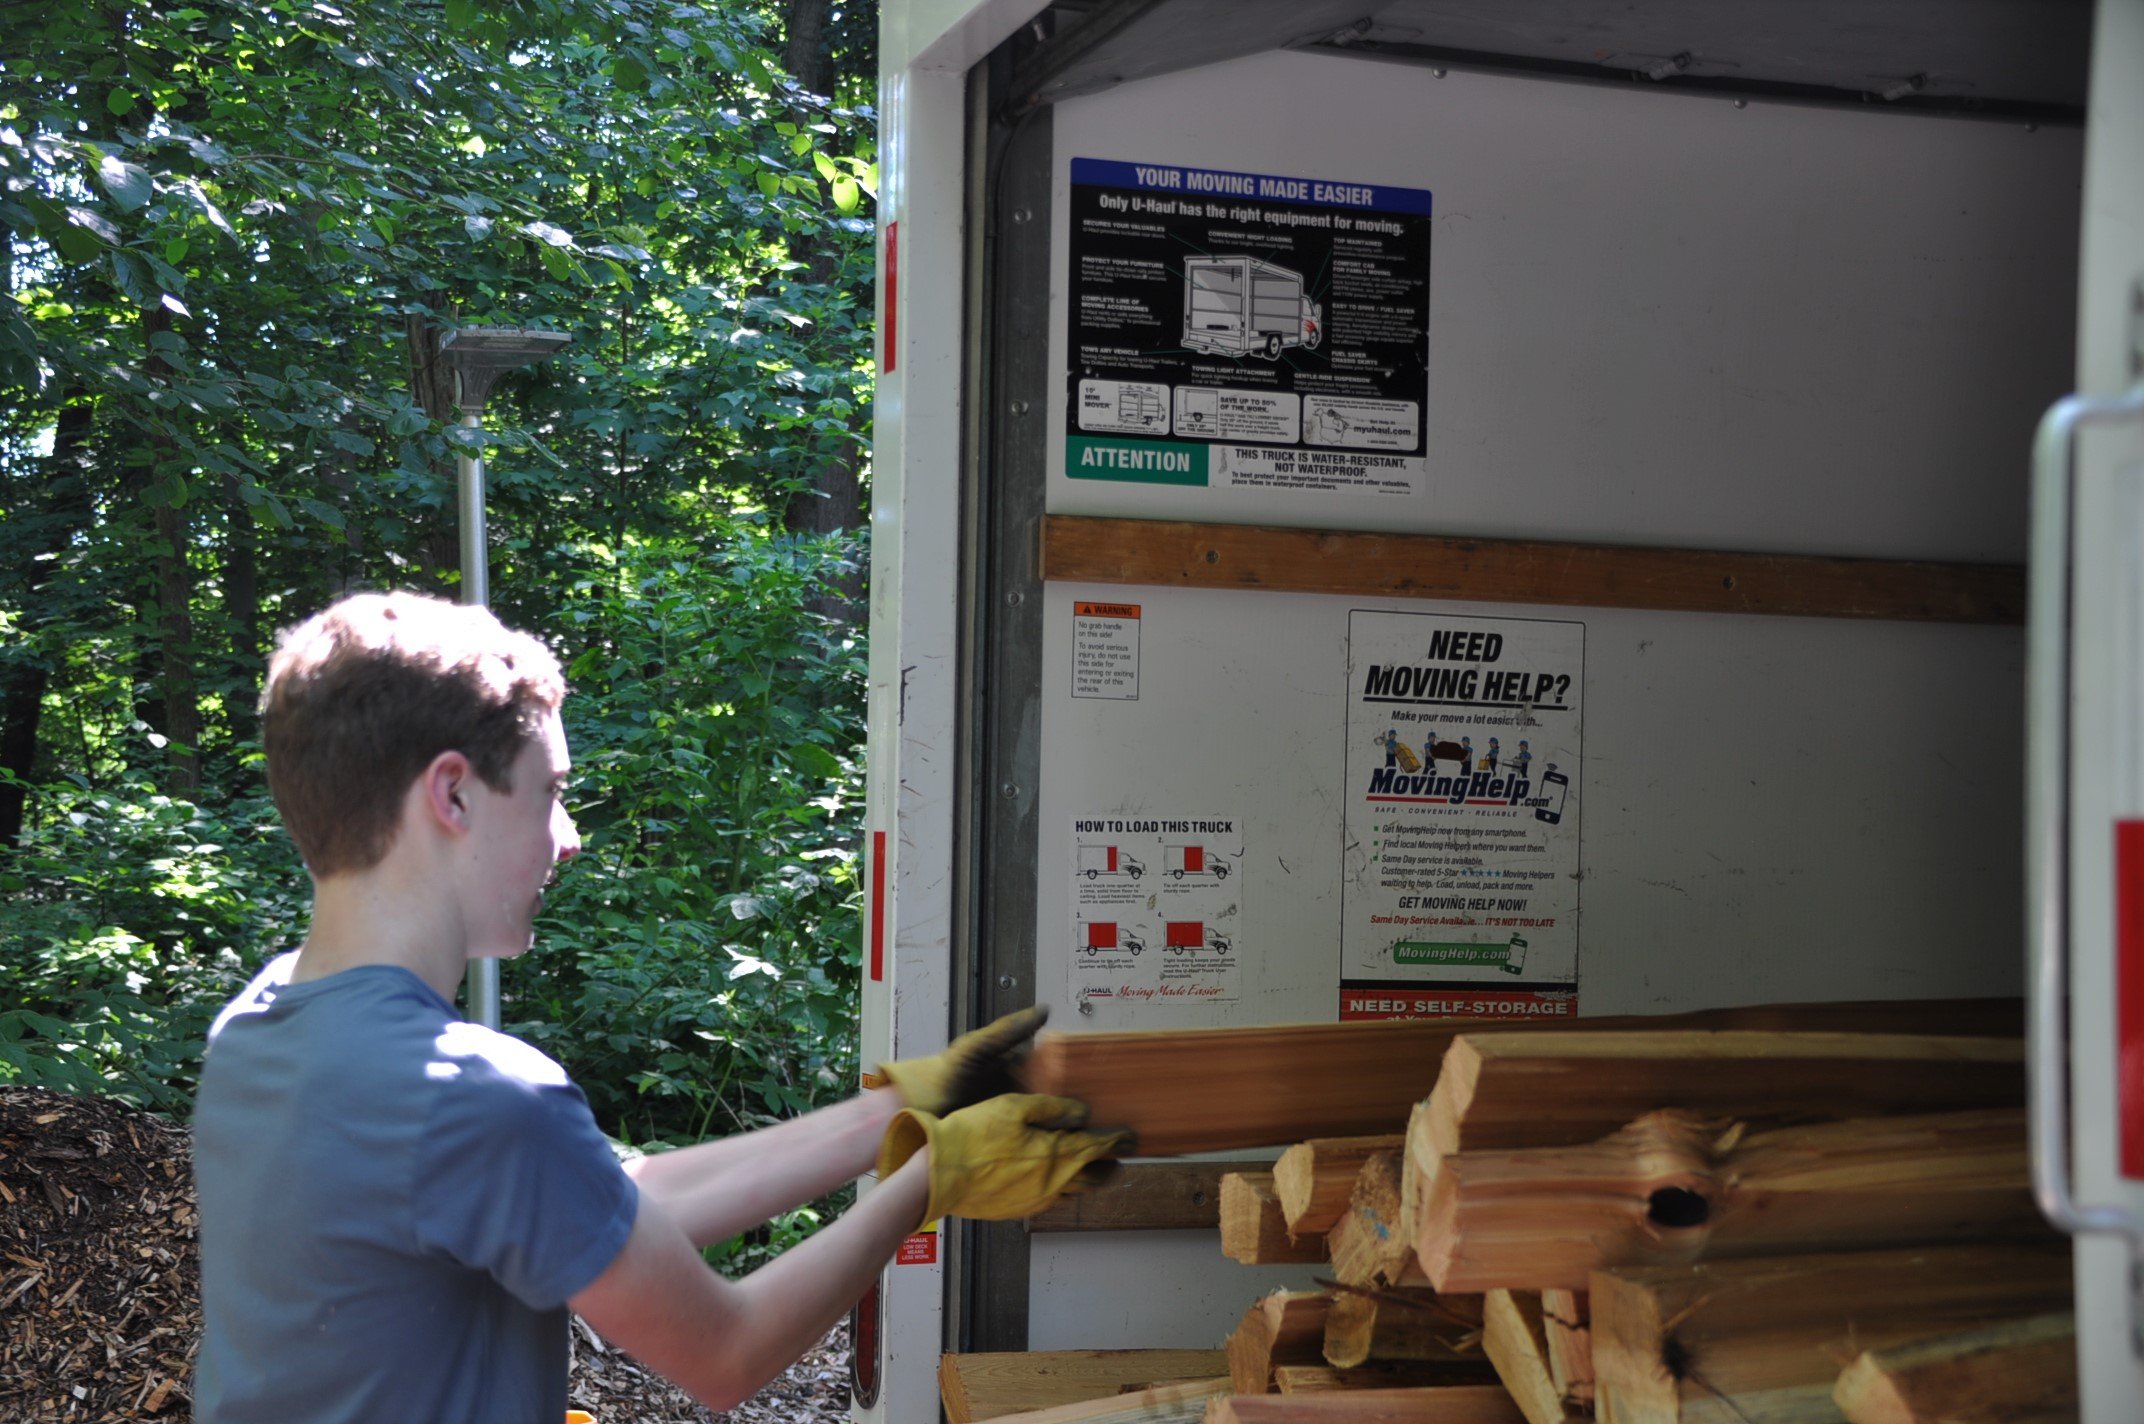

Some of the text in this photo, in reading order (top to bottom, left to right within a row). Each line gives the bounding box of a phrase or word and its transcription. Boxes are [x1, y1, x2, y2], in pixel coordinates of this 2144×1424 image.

[1135, 167, 1372, 206] YOUR MOVING MADE EASIER
[1100, 194, 1404, 236] Only U-Haul has the right equipment for moving.
[1354, 426, 1410, 436] myuhaul.com
[1081, 447, 1189, 472] ATTENTION
[1235, 449, 1406, 470] THIS TRUCK IS WATER-RESISTANT,
[1275, 463, 1367, 478] NOT WATERPROOF.
[1291, 475, 1319, 483] important
[1095, 606, 1132, 616] WARNING
[1428, 630, 1503, 662] NEED
[1114, 671, 1134, 679] exiting
[1364, 665, 1571, 703] MOVING HELP?
[1392, 710, 1416, 721] Make
[1418, 713, 1438, 723] your
[1440, 714, 1464, 723] move
[1473, 715, 1485, 724] lot
[1368, 768, 1549, 807] MovingHelp.com
[1409, 808, 1464, 816] CONVENIENT
[1076, 821, 1232, 833] HOW TO LOAD THIS TRUCK
[1383, 825, 1394, 833] Get
[1396, 826, 1436, 835] MovingHelp
[1454, 827, 1470, 835] from
[1485, 829, 1526, 838] smartphone.
[1383, 840, 1400, 848] Find
[1400, 840, 1416, 848] local
[1418, 841, 1443, 850] Moving
[1445, 842, 1471, 851] Helpers
[1382, 855, 1401, 863] Same
[1403, 855, 1416, 865] Day
[1451, 856, 1483, 866] available.
[1381, 866, 1555, 880] Customer-rated 5-Star Moving Helpers
[1381, 880, 1407, 889] waiting
[1408, 880, 1415, 888] to
[1417, 880, 1432, 889] help.
[1436, 880, 1455, 889] Load,
[1456, 880, 1481, 890] unload,
[1482, 882, 1500, 891] pack
[1515, 883, 1534, 891] more.
[1399, 896, 1526, 911] GET MOVING HELP NOW!
[1371, 915, 1393, 924] Same
[1394, 916, 1409, 926] Day
[1410, 916, 1439, 925] Service
[1440, 917, 1483, 926] Availale...
[1485, 918, 1499, 926] IT'S
[1519, 919, 1534, 927] TOO
[1535, 919, 1555, 927] LATE
[1399, 947, 1510, 961] MovingHelp.com
[1119, 984, 1221, 1000] Moving Made Easier
[1350, 1000, 1568, 1015] NEED SELF-STORAGE
